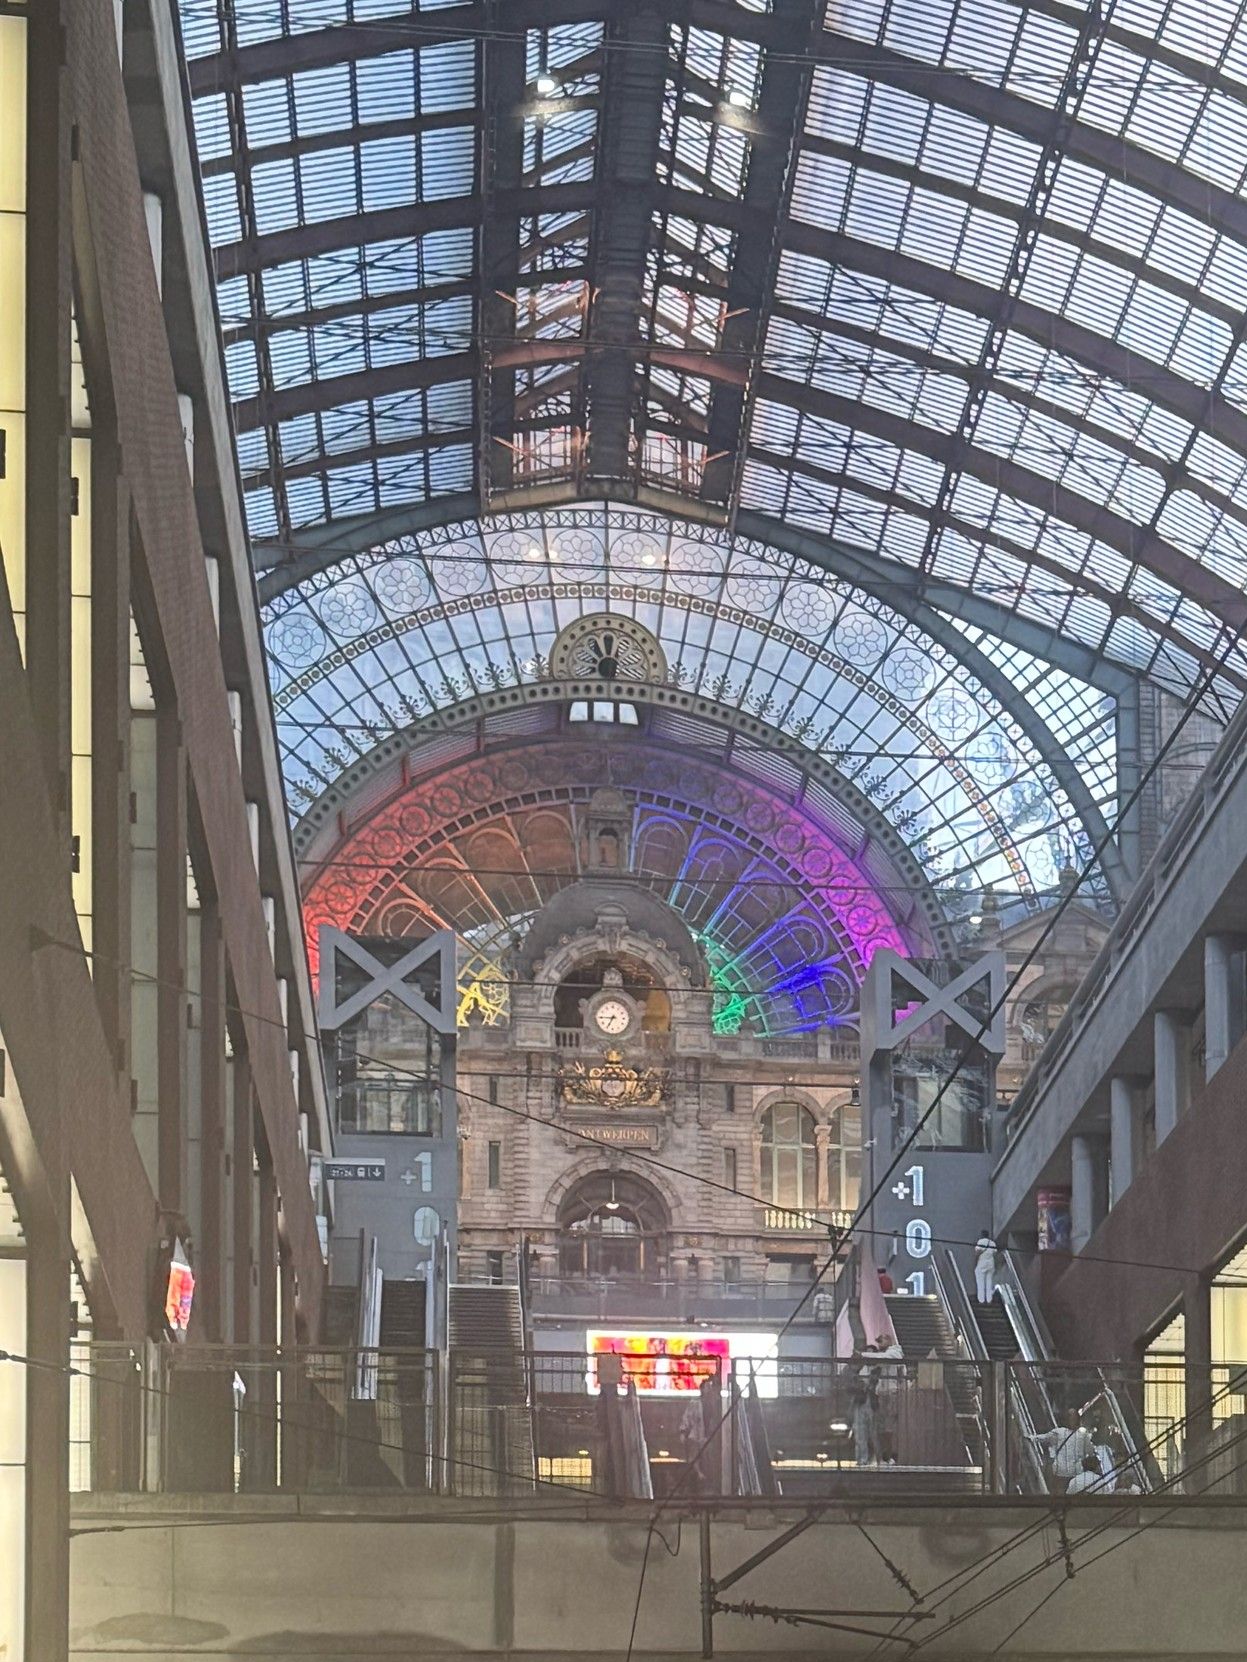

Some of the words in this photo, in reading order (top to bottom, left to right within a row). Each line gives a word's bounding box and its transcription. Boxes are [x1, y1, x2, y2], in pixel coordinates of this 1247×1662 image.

[578, 1128, 649, 1141] ANTWERPEN
[400, 1151, 432, 1192] +1
[891, 1165, 924, 1206] +1
[413, 1206, 440, 1247] 0
[905, 1218, 932, 1259] 0
